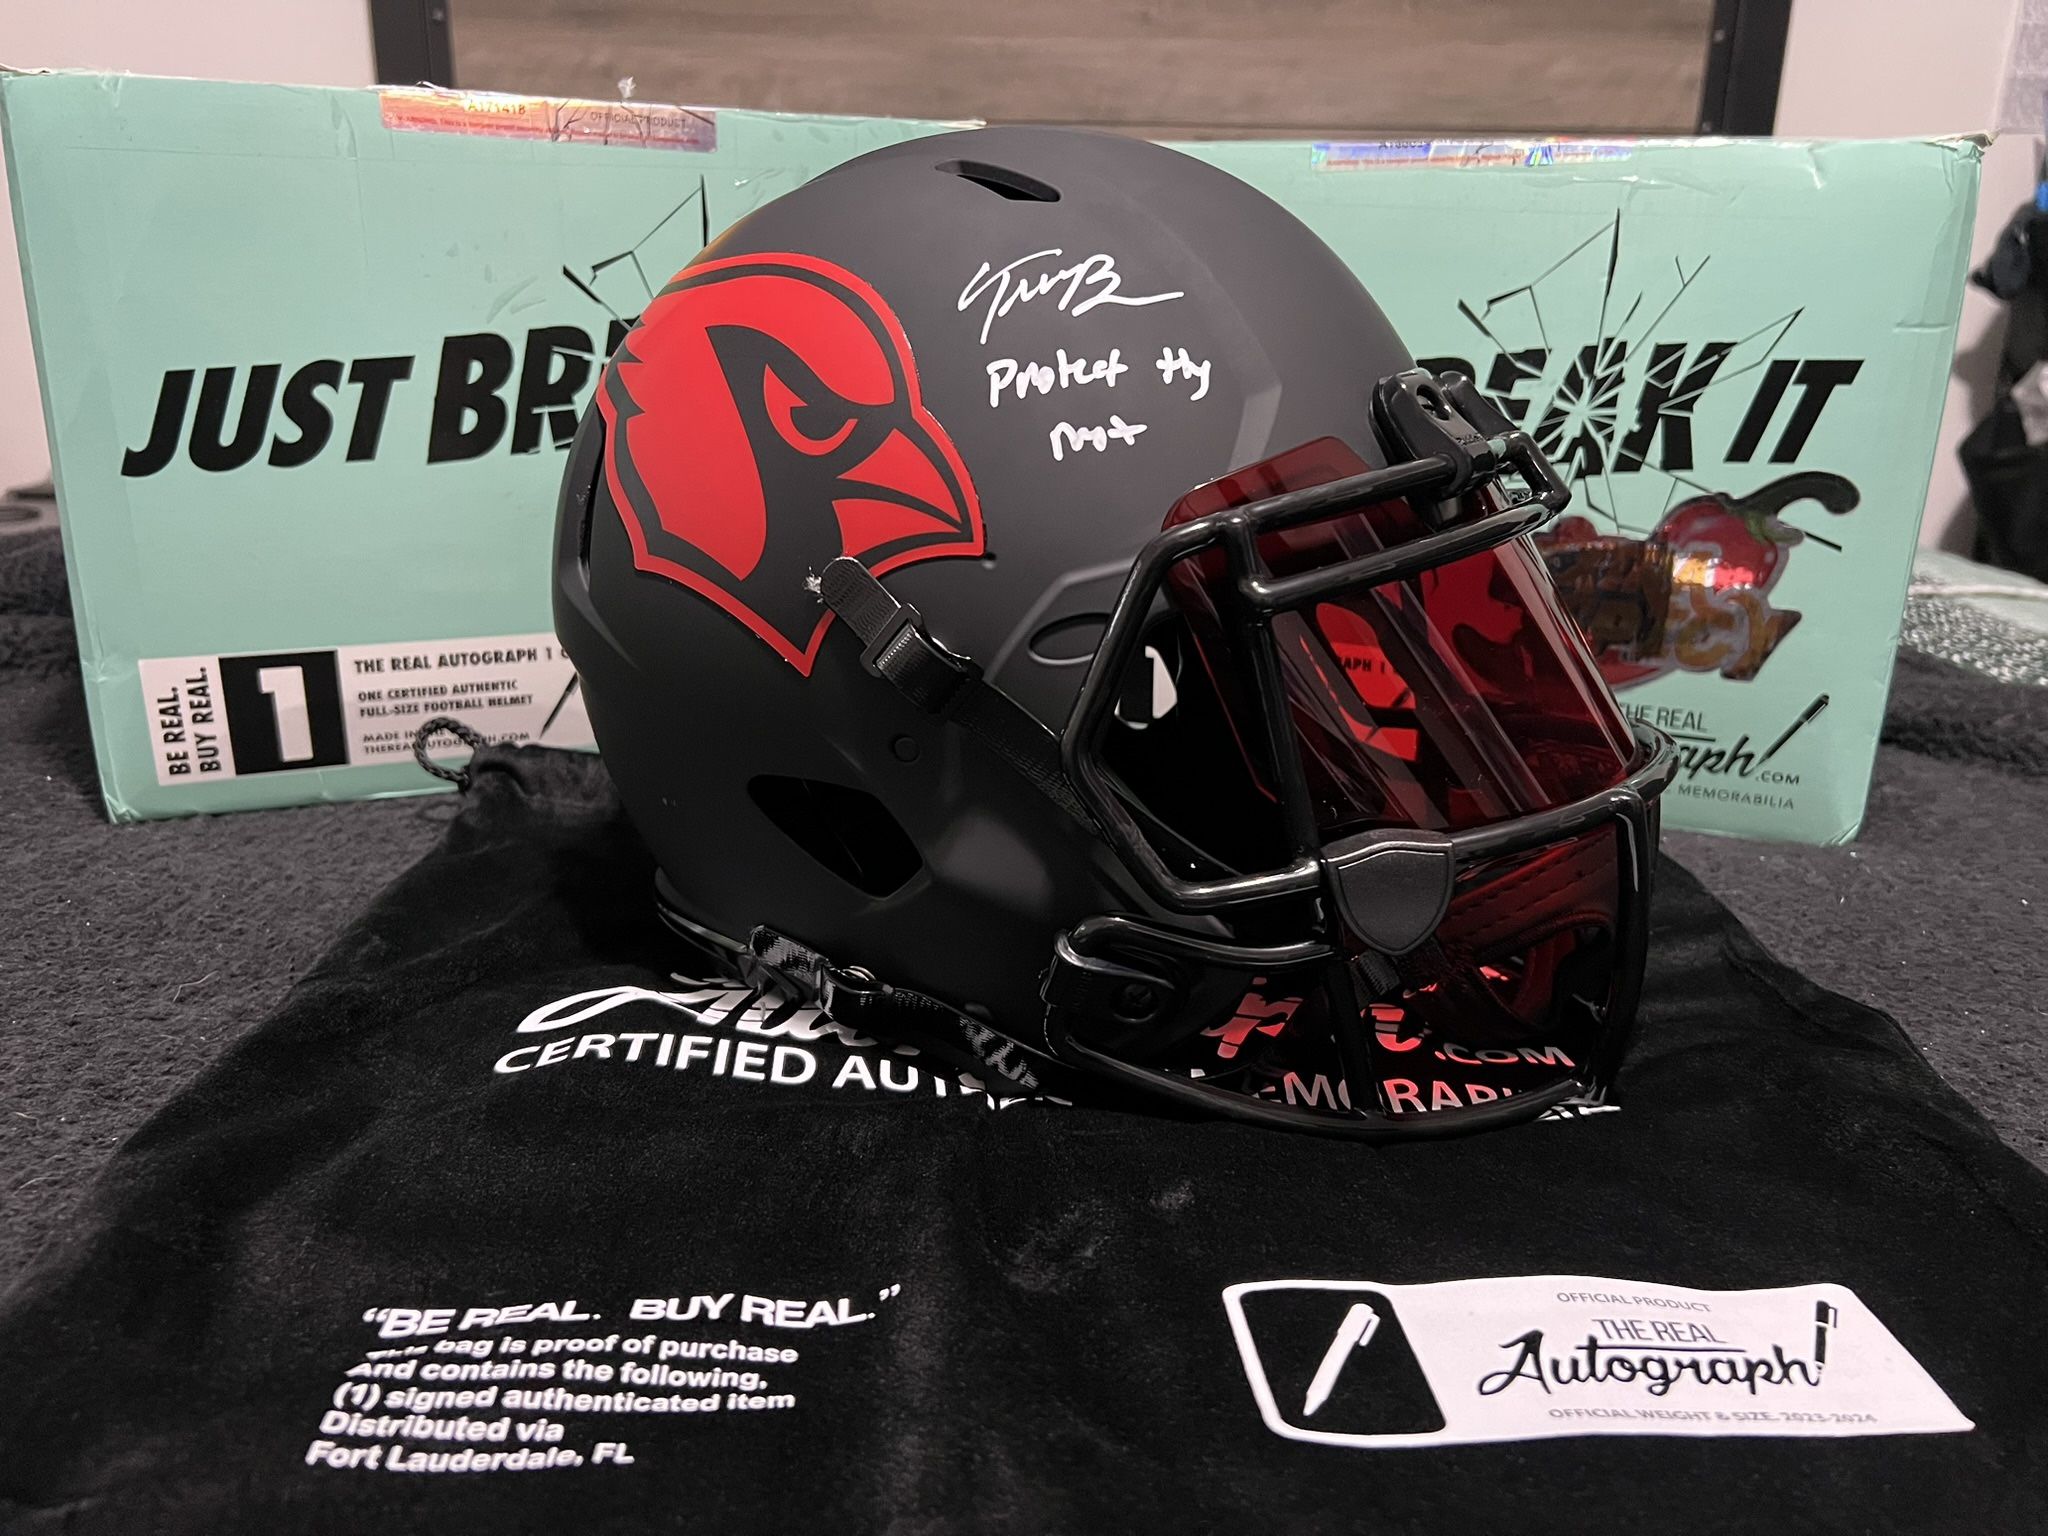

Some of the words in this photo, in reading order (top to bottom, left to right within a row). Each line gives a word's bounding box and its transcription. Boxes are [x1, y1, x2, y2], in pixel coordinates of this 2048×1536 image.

[638, 115, 688, 128] PRODUCT
[120, 353, 416, 478] JUST
[1722, 358, 1866, 464] IT
[353, 657, 386, 674] THE
[391, 655, 432, 673] REAL
[437, 648, 538, 669] AUTOGRAPH
[185, 666, 215, 724] REAL.
[358, 690, 383, 702] ONE
[387, 685, 448, 699] CERTIFIED
[452, 680, 518, 695] AUTHENTIC
[359, 703, 420, 718] FULL-SIZE
[424, 699, 485, 714] FOOTBALL
[488, 694, 534, 707] HELMET
[156, 687, 186, 744] REAL.
[257, 664, 315, 763] 1
[1656, 706, 1708, 732] REAL
[363, 731, 400, 743] MADE
[166, 750, 192, 777] BE
[193, 732, 222, 773] BUY
[1677, 784, 1795, 810] MEMORABILIA
[493, 1032, 817, 1085] CERTIFIED
[457, 1300, 602, 1331] REAL.
[629, 1293, 735, 1321] BUY
[1556, 1292, 1632, 1306] OFFICIAL
[1632, 1296, 1713, 1313] PRODUCT
[1592, 1318, 1651, 1341] THE
[1651, 1319, 1728, 1344] REAL
[432, 1339, 494, 1359] bag
[498, 1336, 527, 1355] is
[531, 1334, 620, 1356] proof
[621, 1334, 657, 1355] of
[658, 1338, 799, 1364] purchase
[1477, 1330, 1822, 1396] Autograph
[344, 1359, 418, 1381] And
[419, 1359, 556, 1381] contains
[562, 1359, 614, 1383] the
[332, 1381, 382, 1412] (1)
[383, 1386, 498, 1414] signed
[501, 1387, 721, 1413] authenticated
[726, 1393, 796, 1411] item
[319, 1409, 511, 1442] Distributed
[515, 1418, 565, 1443] via
[1548, 1408, 1636, 1419] OFFICIAL
[1634, 1408, 1713, 1421] WEIGHT
[304, 1439, 383, 1470] Fort
[590, 1442, 635, 1464] FL
